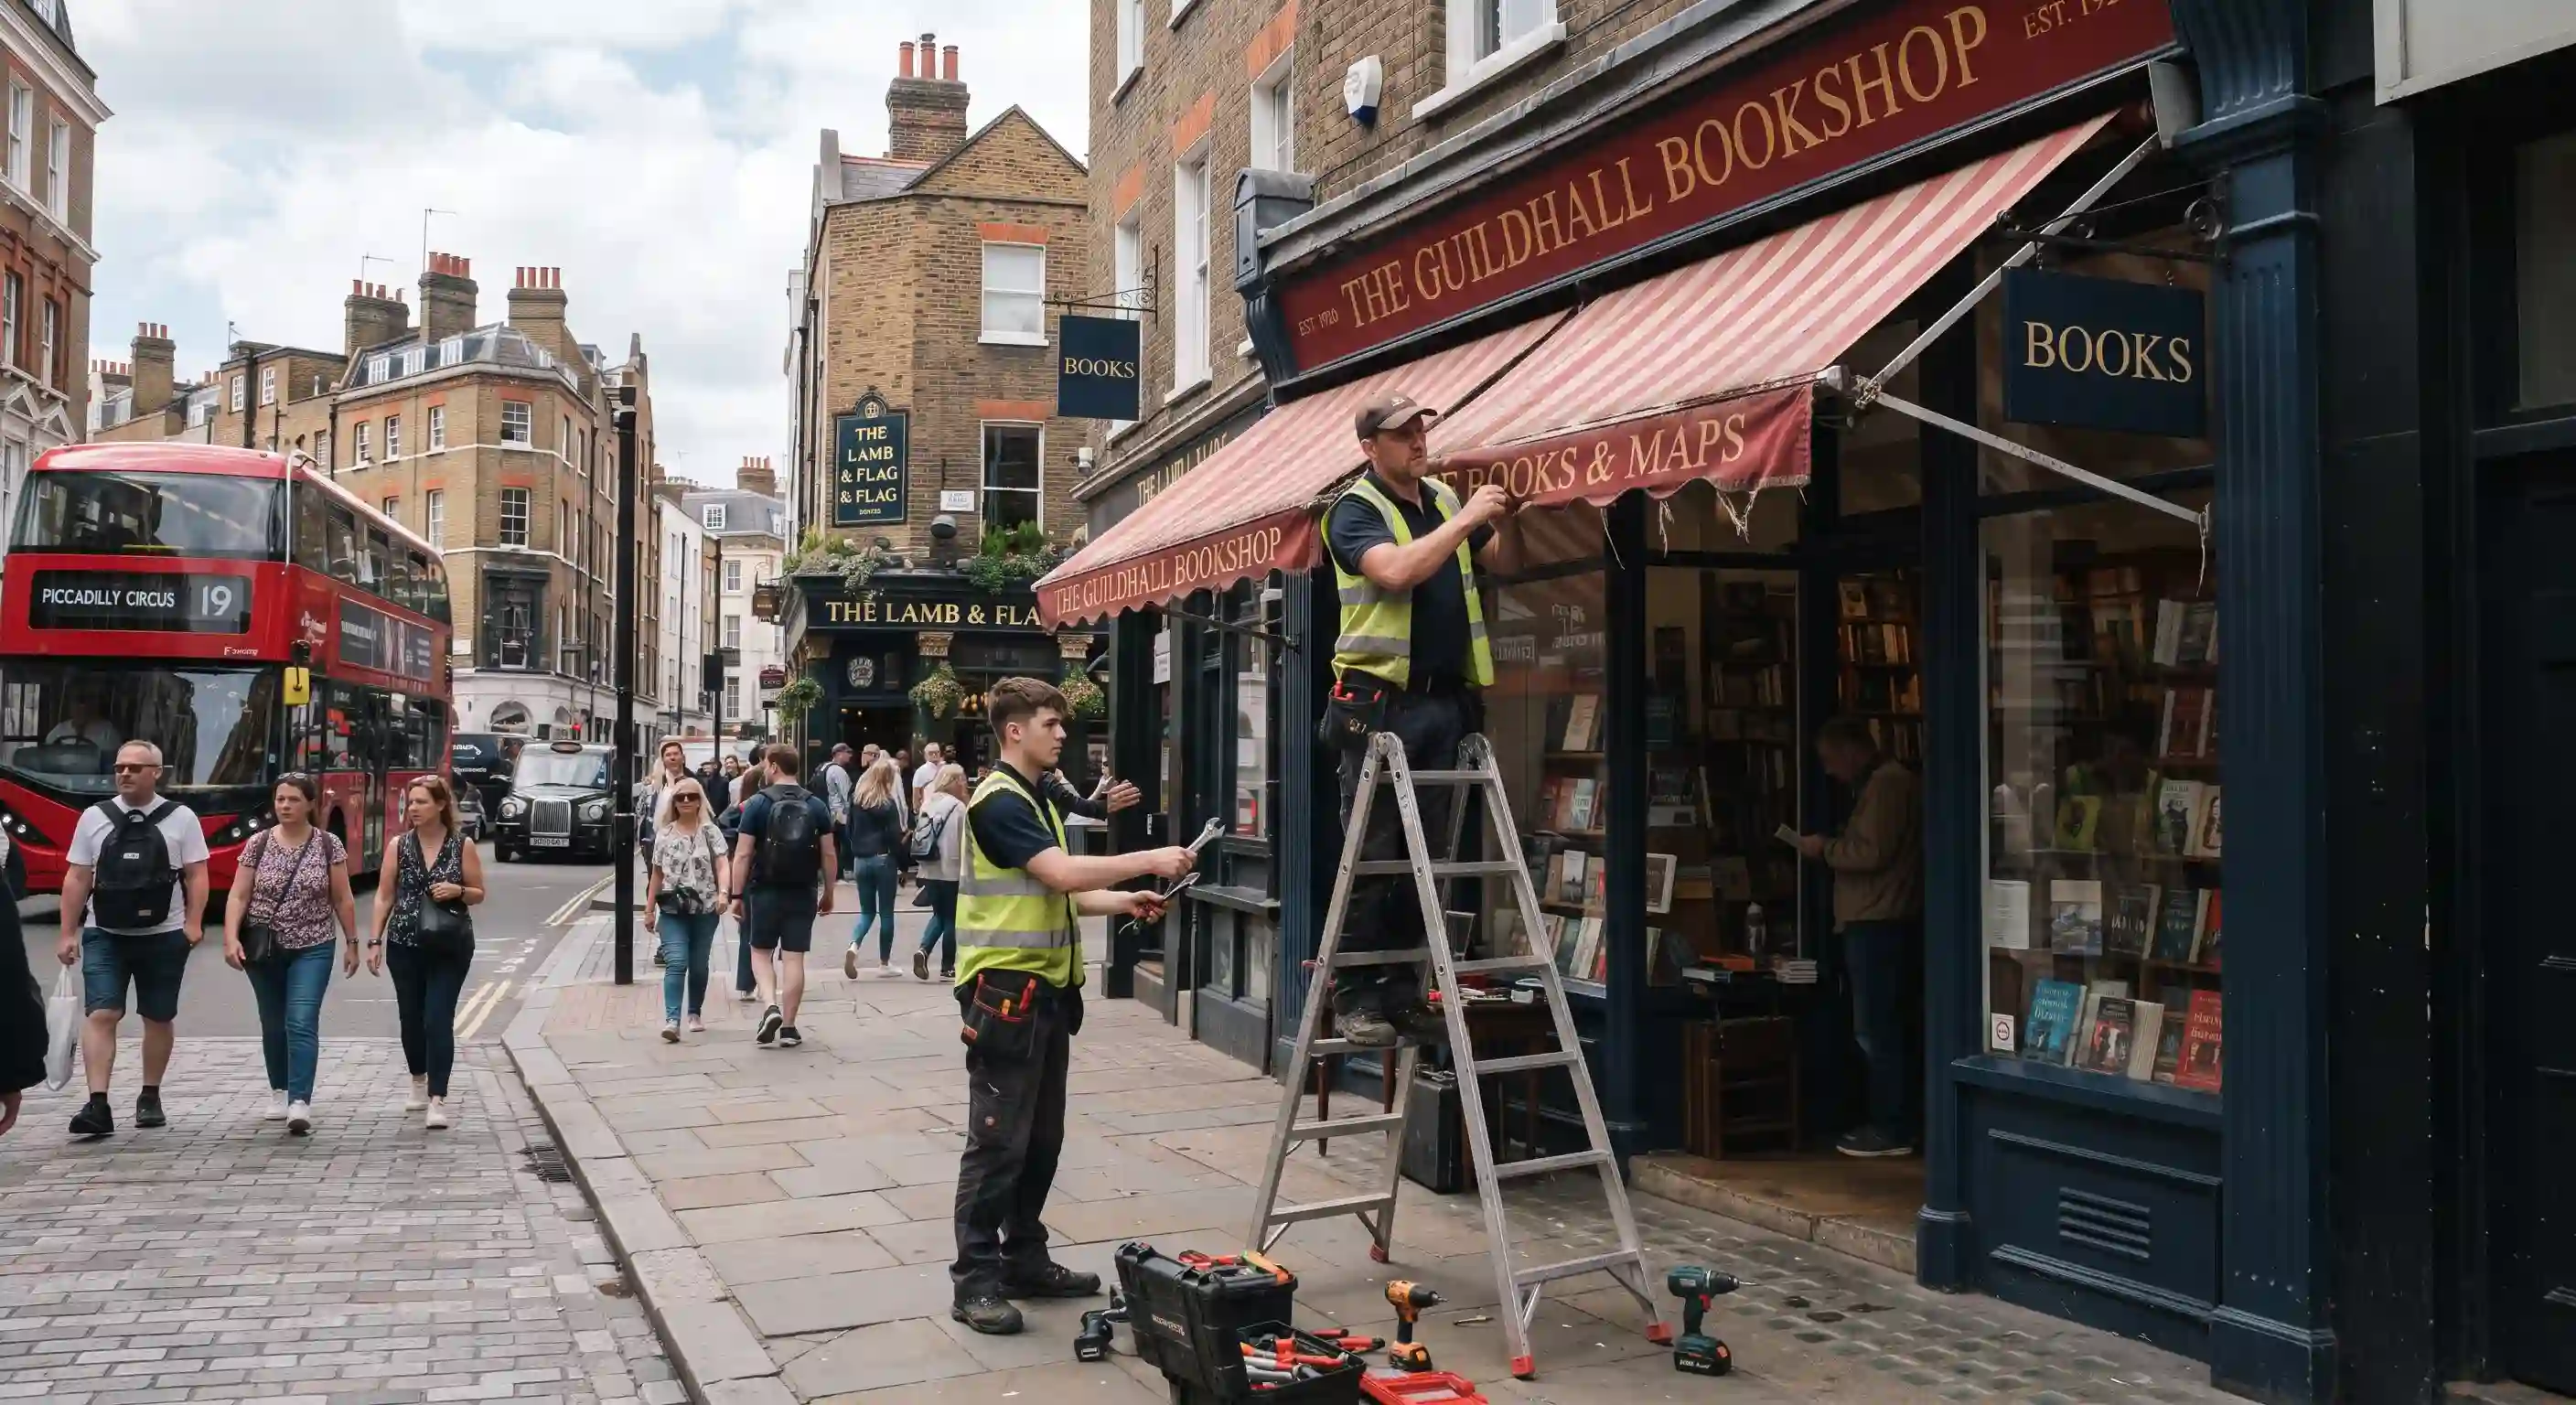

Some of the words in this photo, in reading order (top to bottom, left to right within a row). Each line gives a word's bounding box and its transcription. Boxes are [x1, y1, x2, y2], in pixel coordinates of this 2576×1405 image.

[2023, 0, 2072, 39] EST.
[1341, 262, 1410, 328] THE
[1413, 157, 1653, 301] GUILDHALL
[1656, 5, 1988, 203] BOOKSHOP
[1298, 316, 1315, 337] EST
[2023, 320, 2193, 384] BOOKS
[1064, 357, 1136, 379] BOOKS
[854, 425, 887, 442] THE
[847, 445, 894, 463] LAMB
[1586, 441, 1615, 487] &
[1625, 413, 1746, 479] MAPS
[841, 468, 853, 483] &
[856, 466, 898, 483] FLAG
[840, 490, 853, 504] &
[855, 488, 897, 503] FLAG
[1054, 583, 1081, 617] THE
[1083, 556, 1172, 607] GUILDHALL
[1175, 526, 1283, 585] BOOKSHOP
[41, 588, 122, 606] PICCADILLY
[125, 590, 176, 608] CIRCUS
[201, 585, 232, 617] 19
[825, 601, 877, 623] THE
[885, 602, 961, 624] LAMB
[967, 604, 987, 626] &
